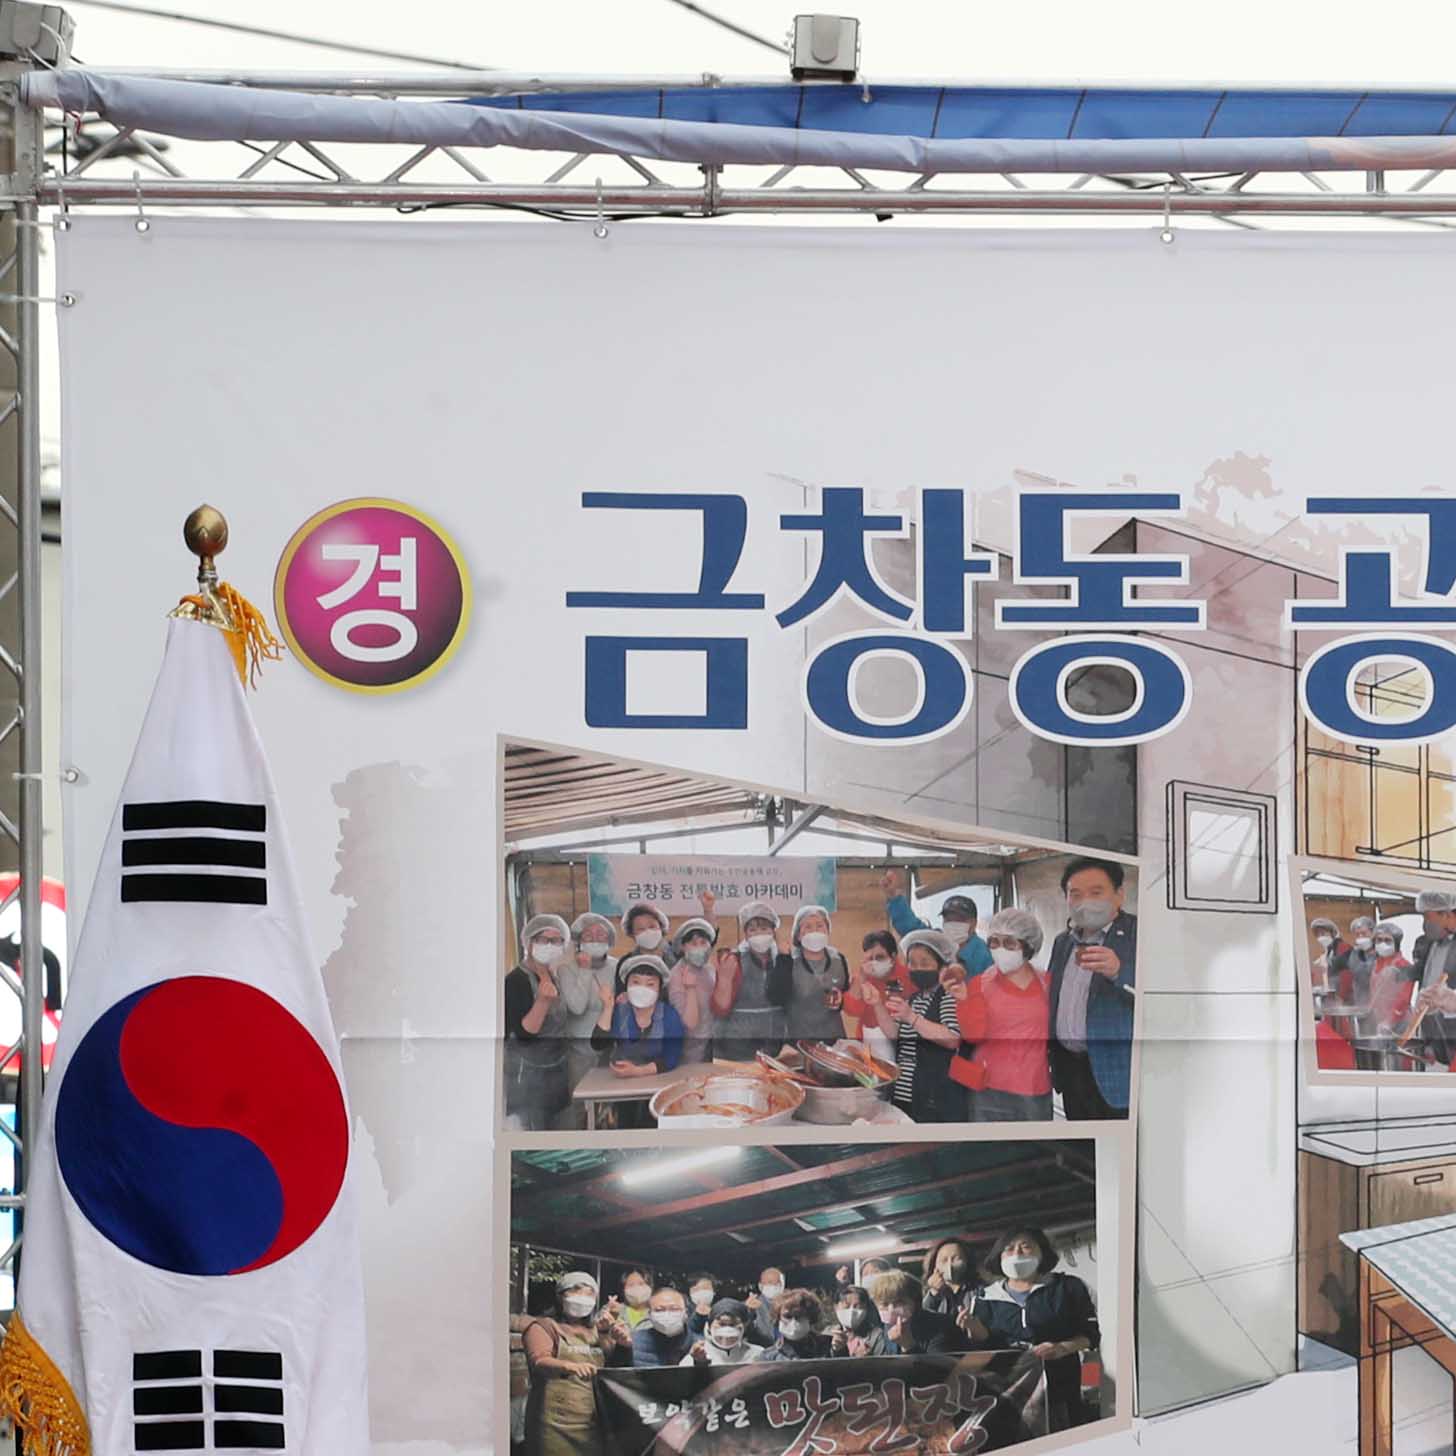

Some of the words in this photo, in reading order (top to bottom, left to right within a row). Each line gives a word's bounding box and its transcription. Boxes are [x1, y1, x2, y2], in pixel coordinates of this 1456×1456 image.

[317, 535, 423, 662] 경
[564, 487, 1201, 738] 금창동
[626, 883, 673, 901] 금창동
[744, 882, 803, 900] 아카데미
